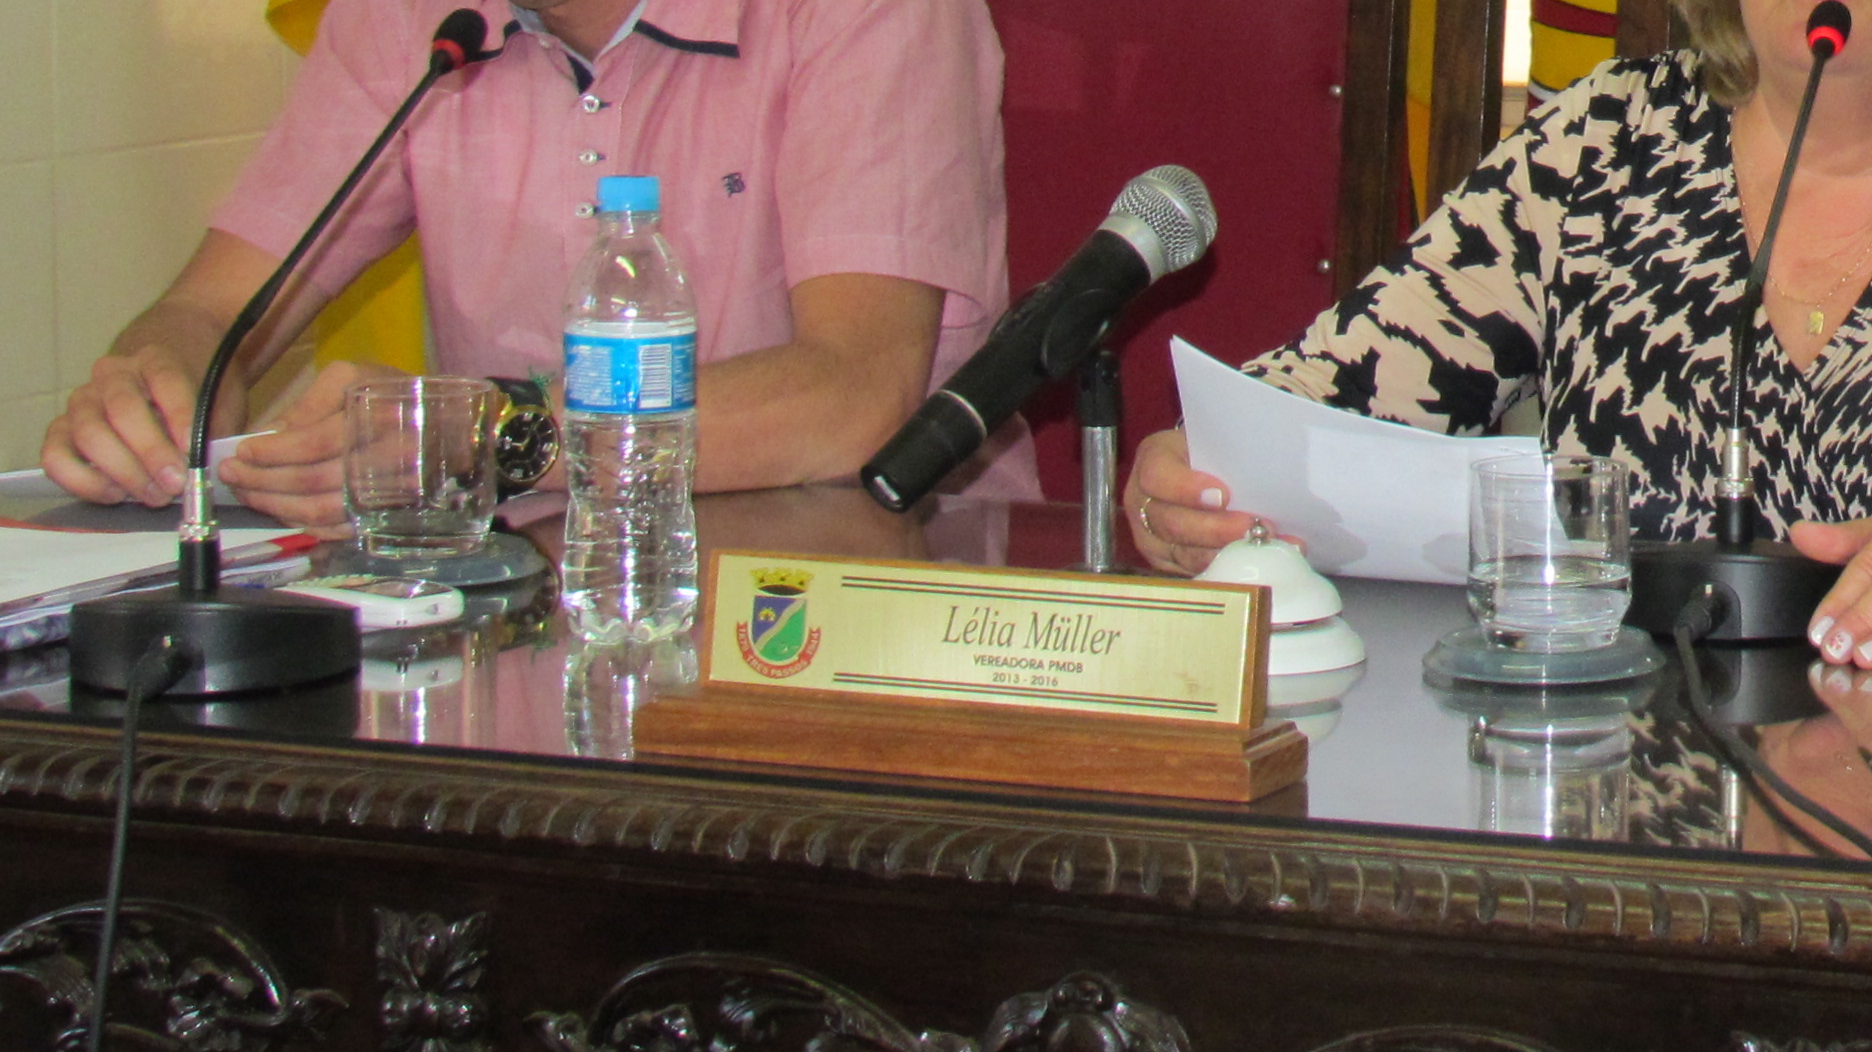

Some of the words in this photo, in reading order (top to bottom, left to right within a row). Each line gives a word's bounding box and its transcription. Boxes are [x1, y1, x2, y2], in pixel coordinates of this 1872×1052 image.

[942, 605, 1016, 649] Lélia
[1024, 611, 1121, 656] Müller
[973, 654, 1044, 671] VEREADORA
[1049, 659, 1084, 674] PMDB
[992, 672, 1020, 685] 2013
[1031, 675, 1059, 688] 2016
